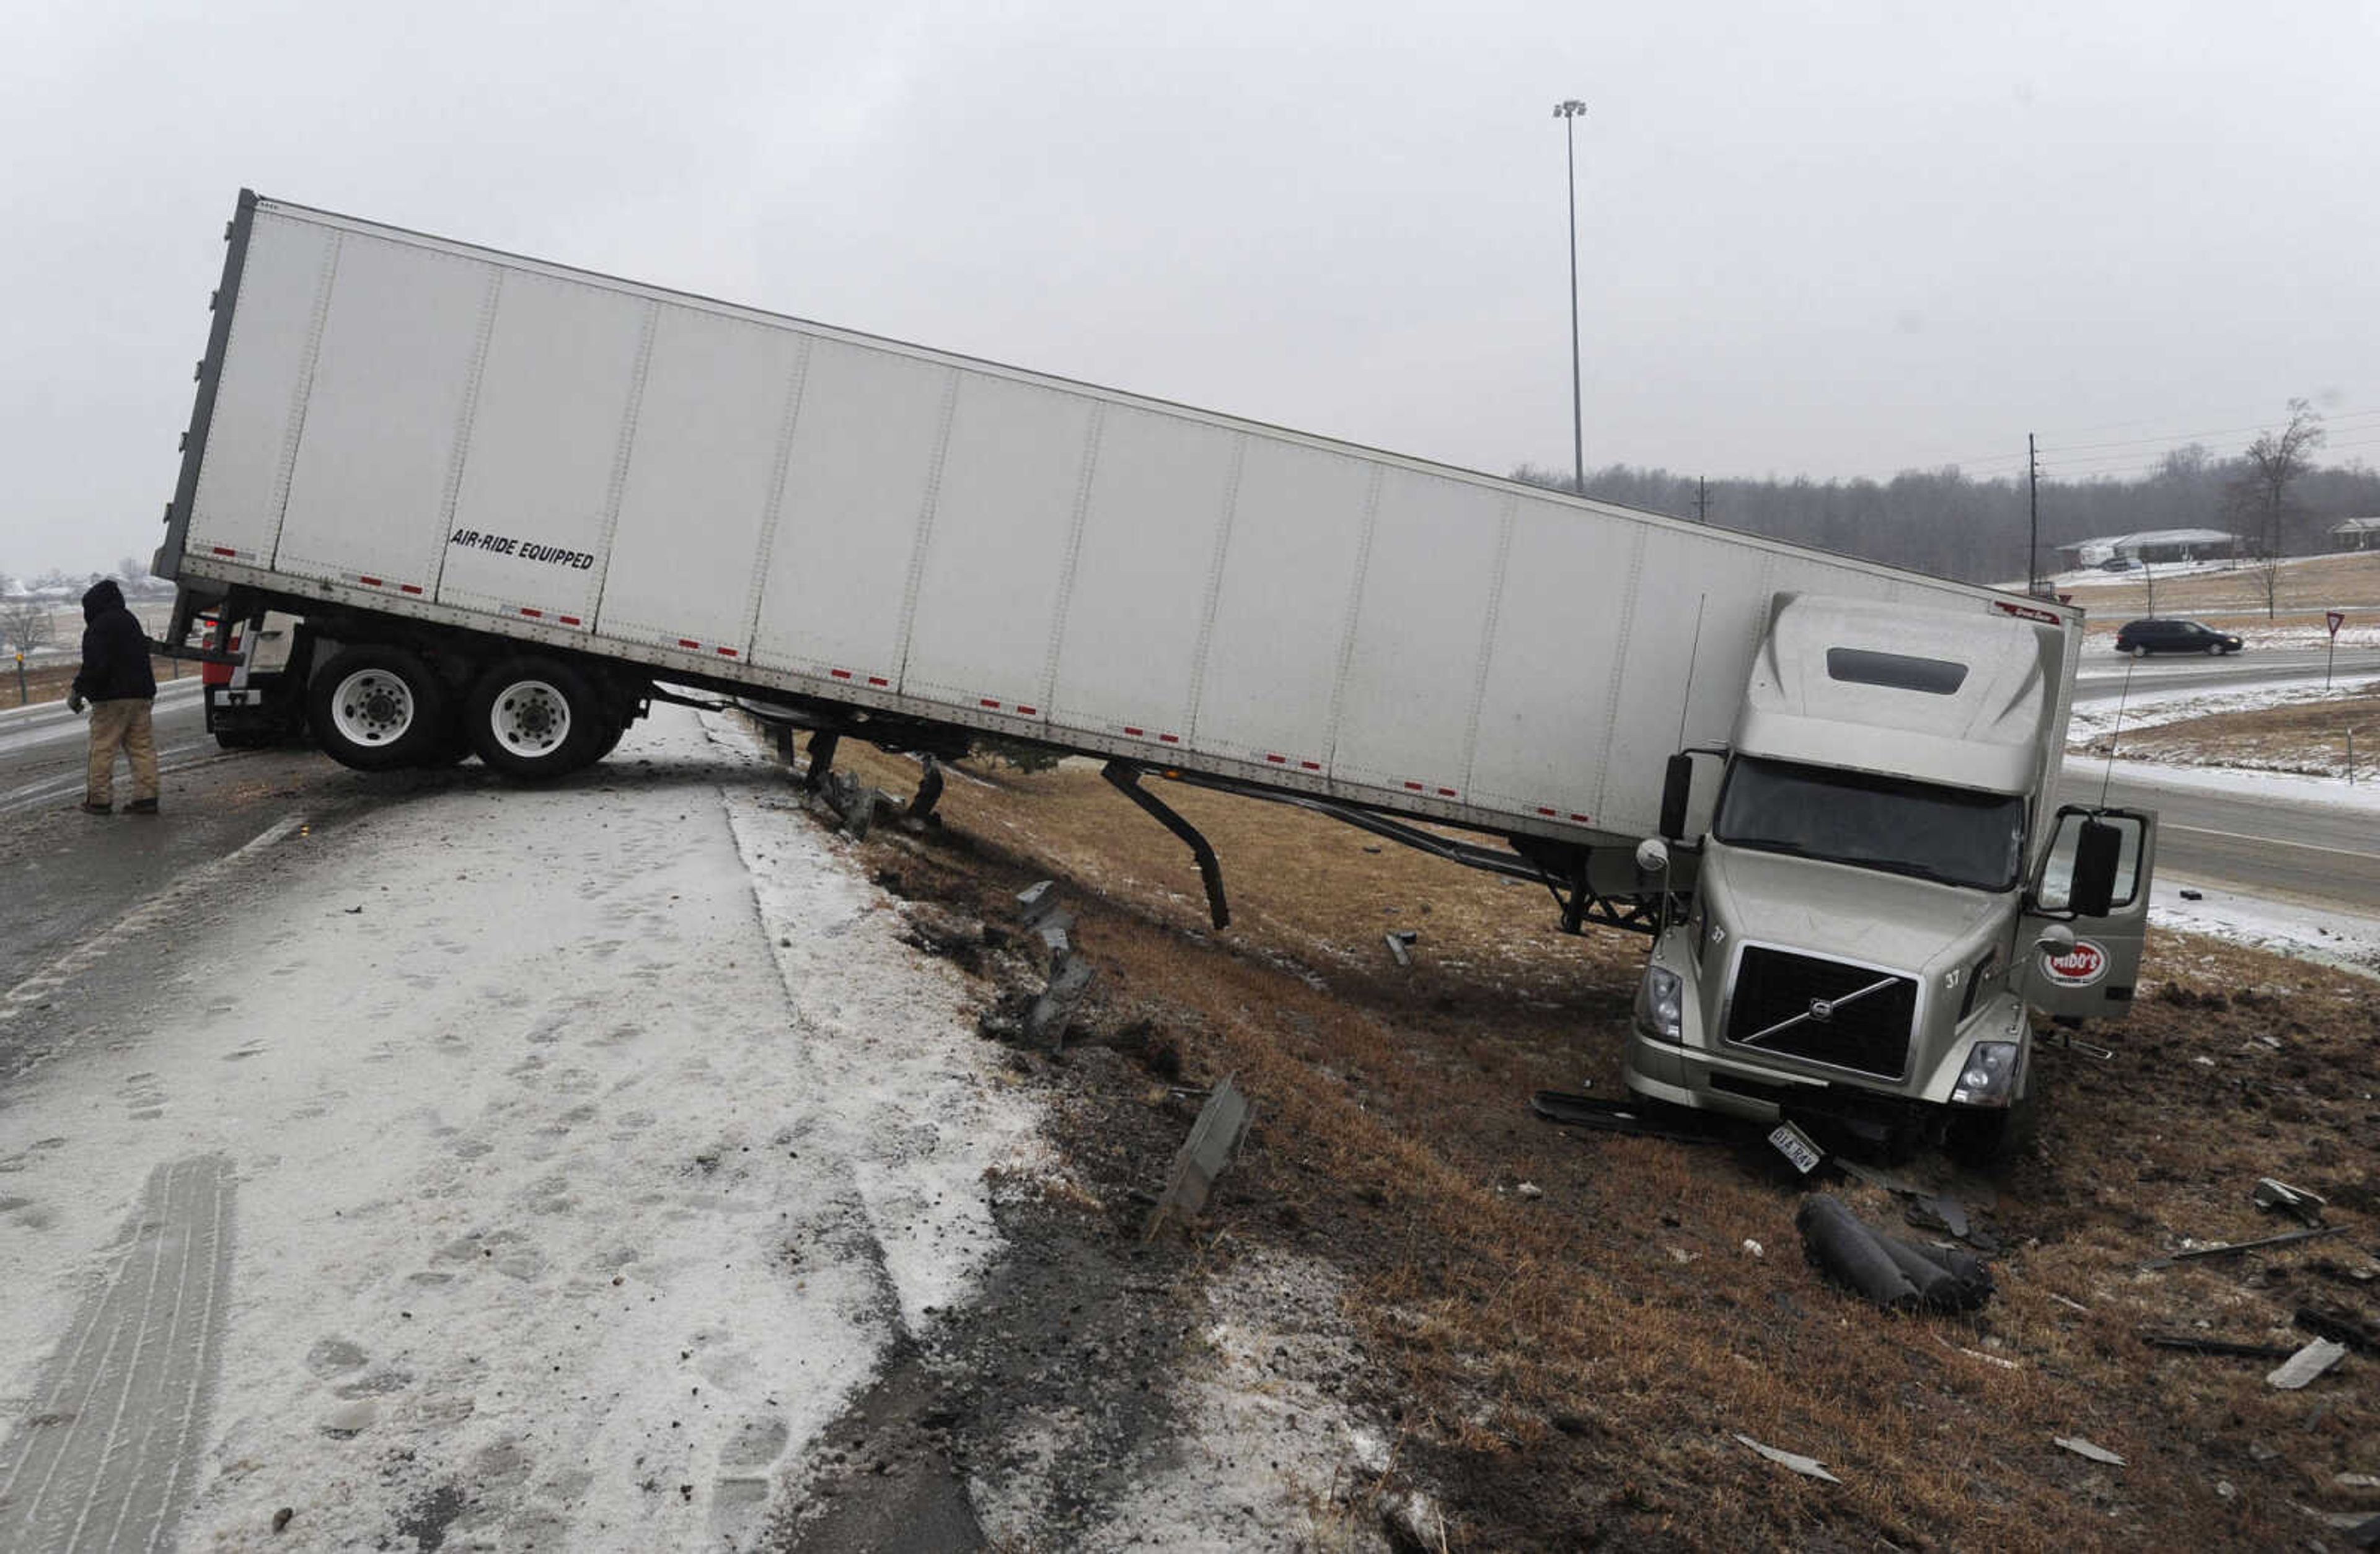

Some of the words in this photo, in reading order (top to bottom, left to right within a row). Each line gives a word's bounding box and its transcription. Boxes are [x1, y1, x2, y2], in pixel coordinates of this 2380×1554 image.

[451, 529, 518, 556] AIR-RIDE
[519, 543, 594, 569] EQUIPPED
[1945, 969, 1960, 989] 37
